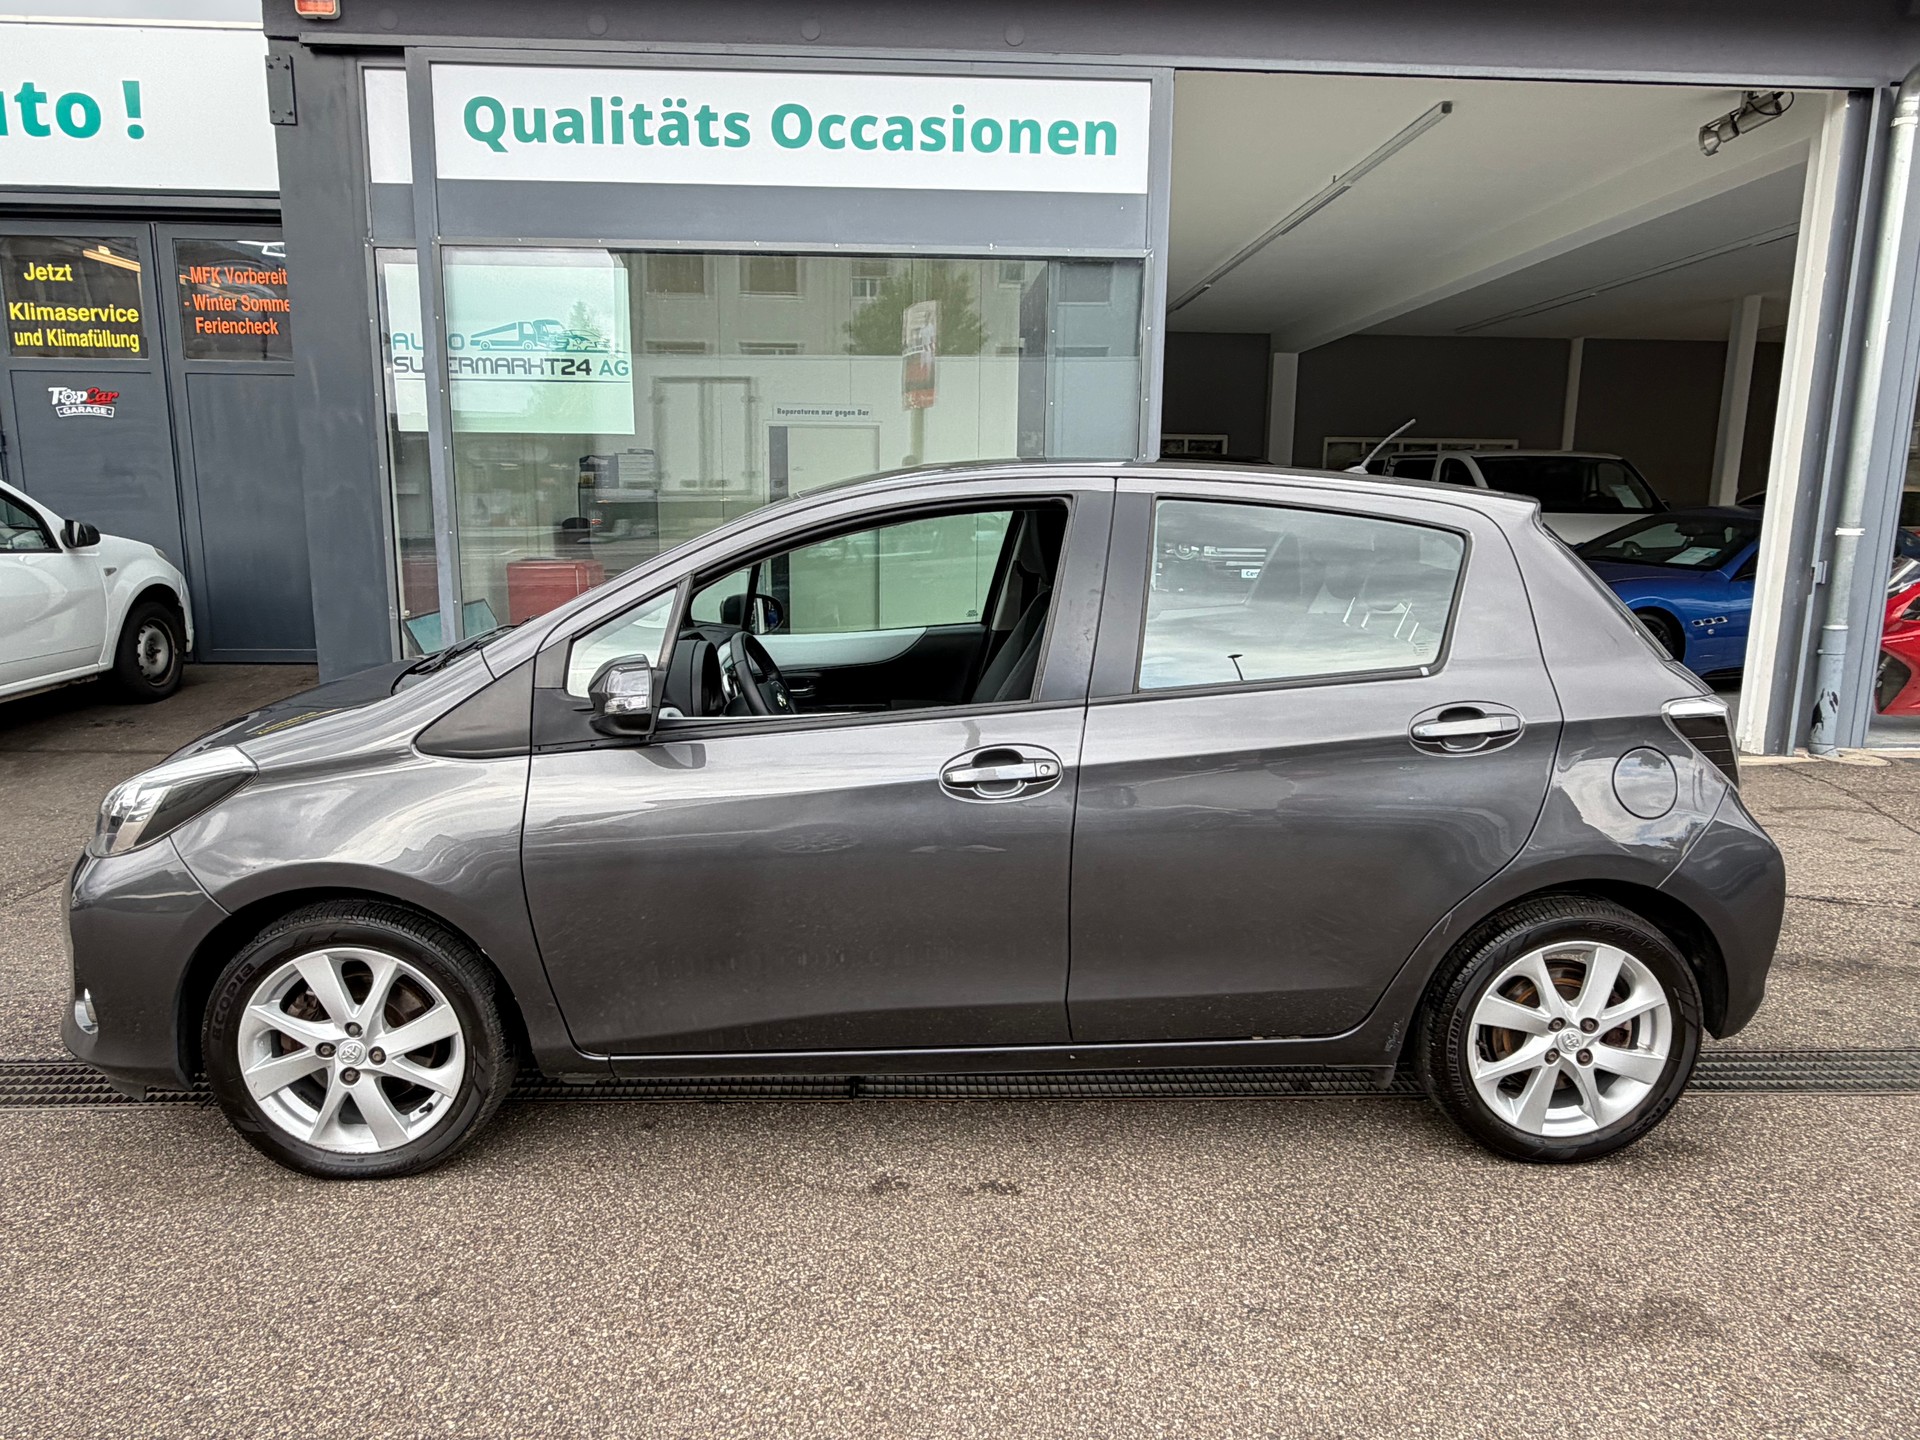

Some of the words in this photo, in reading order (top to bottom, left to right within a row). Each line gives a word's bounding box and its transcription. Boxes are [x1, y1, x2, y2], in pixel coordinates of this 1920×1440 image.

[0, 81, 102, 139] to
[463, 95, 751, 153] Qualitäts
[770, 103, 1118, 156] Occasionen
[23, 262, 73, 282] Jetzt
[190, 266, 222, 284] MFK
[224, 267, 289, 285] Vorbereit
[9, 302, 139, 323] Klimaservice
[192, 294, 238, 312] Winter
[195, 317, 279, 336] Feriencheck
[14, 328, 44, 347] und
[46, 328, 140, 353] Klimafüllung
[392, 332, 465, 351] AUO
[393, 355, 592, 376] SUERMARKT24
[599, 359, 629, 377] AG
[62, 406, 108, 416] GARAGE
[777, 407, 820, 417] Reparaturen
[821, 408, 833, 416] nur
[834, 408, 856, 418] gegen
[857, 408, 869, 416] Bar
